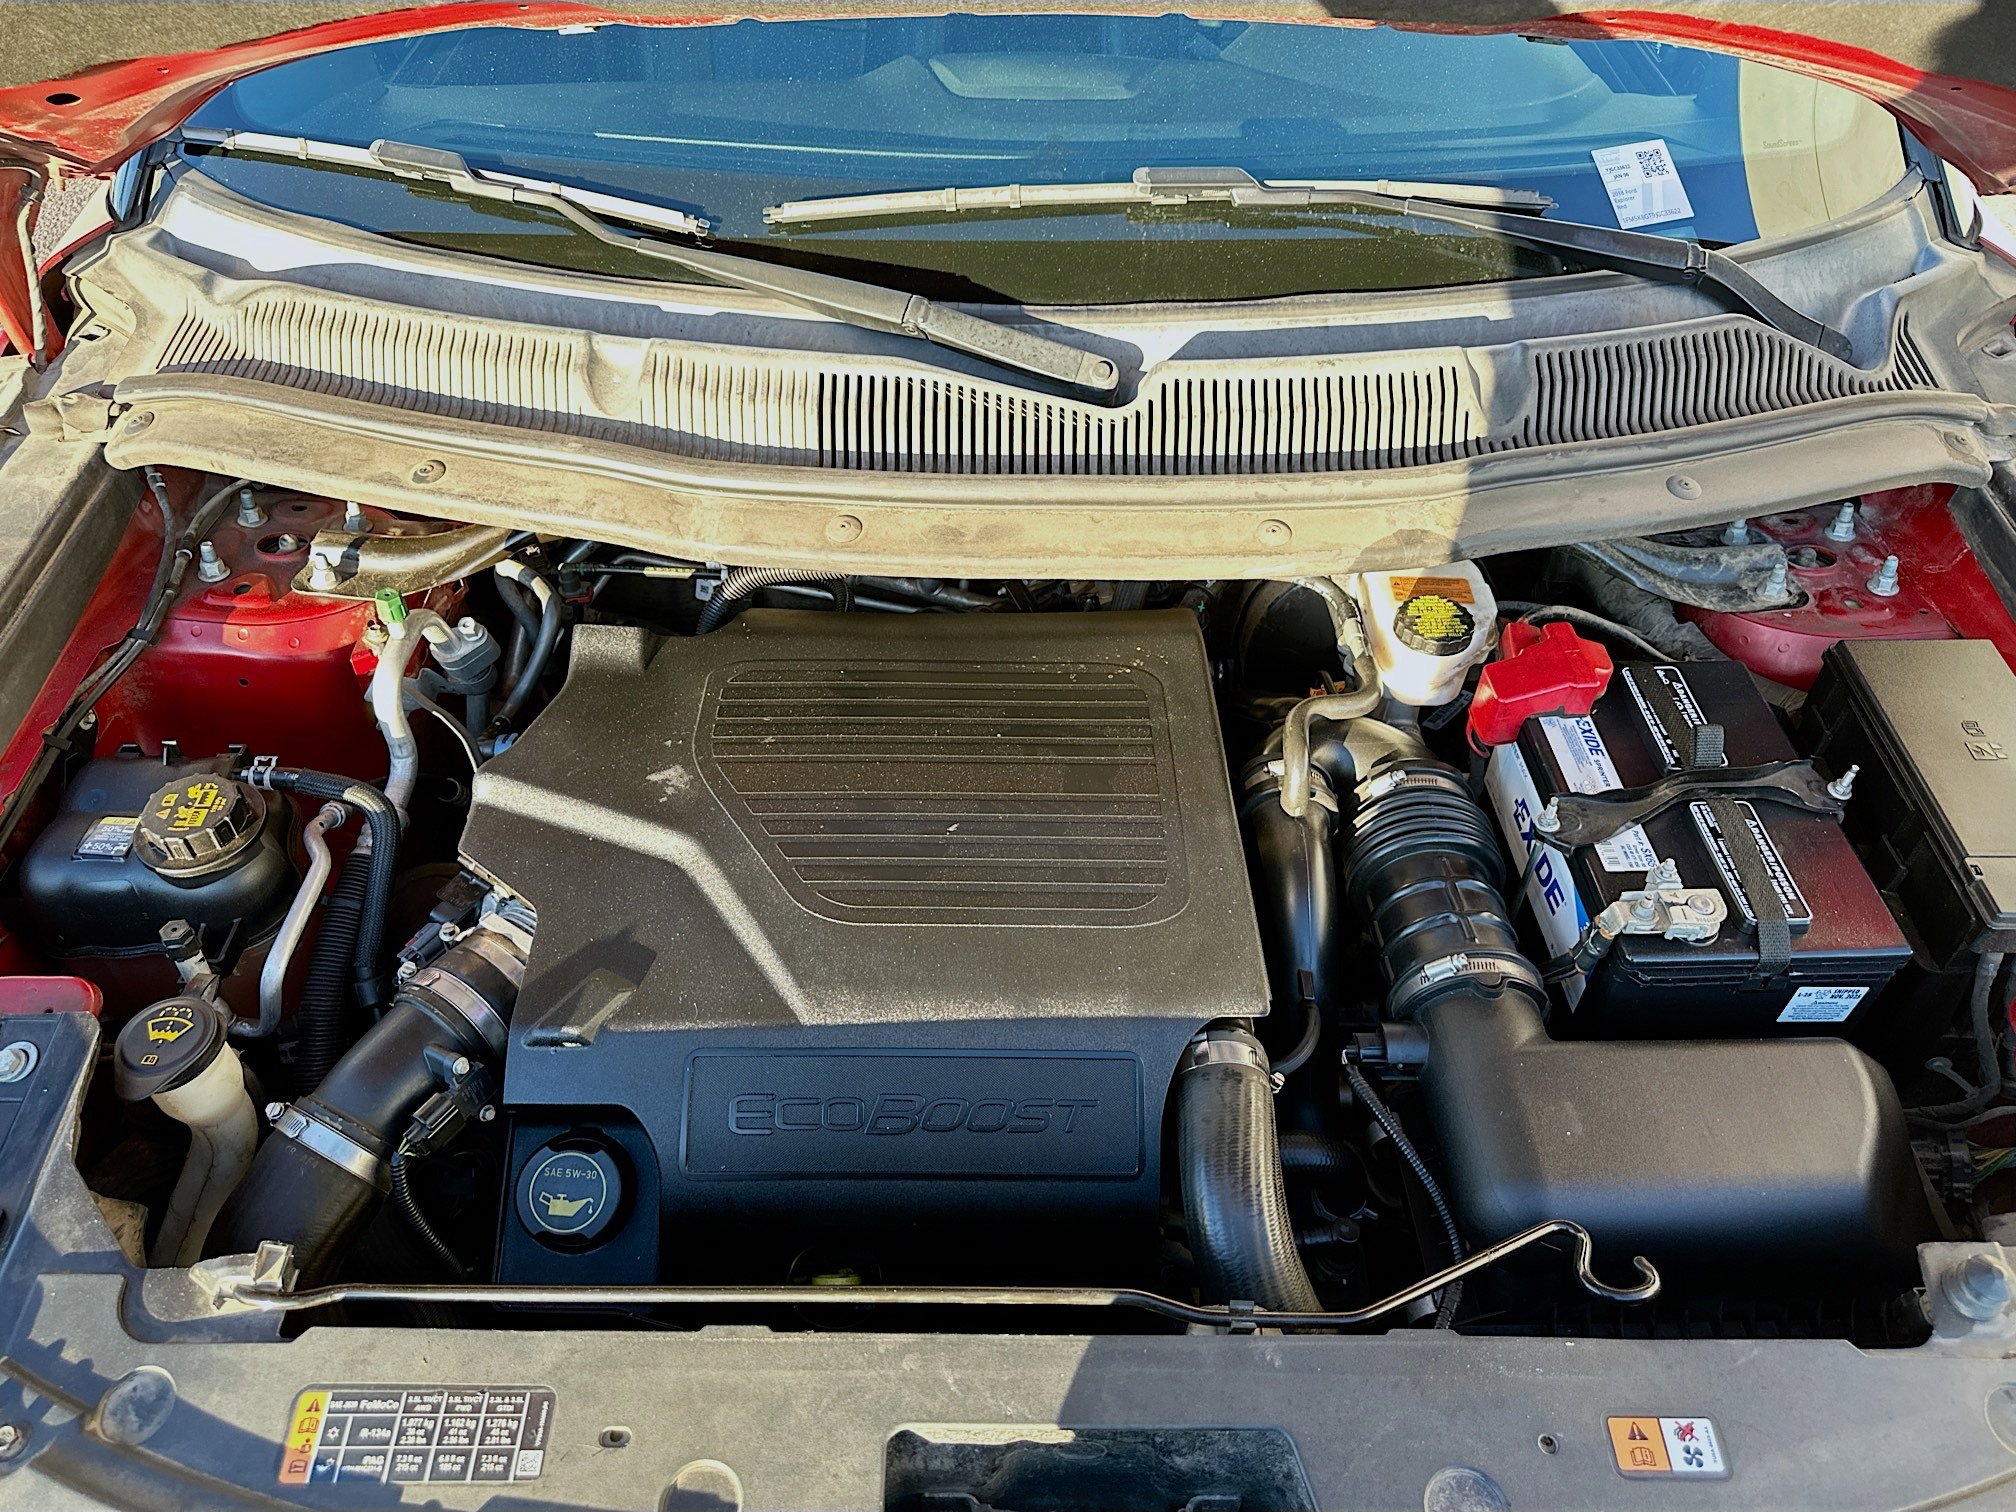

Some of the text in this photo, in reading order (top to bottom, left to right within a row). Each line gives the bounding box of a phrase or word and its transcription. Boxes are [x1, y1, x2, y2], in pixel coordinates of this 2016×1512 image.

[1575, 717, 1605, 758] EXIDE
[1594, 759, 1611, 788] SPRINTER
[1513, 797, 1566, 917] EXDE
[544, 1167, 598, 1180] SAE 5W-30
[359, 1399, 400, 1410] FoMoCo
[423, 1418, 435, 1430] kg
[465, 1418, 477, 1430] kg
[507, 1418, 519, 1430] kg
